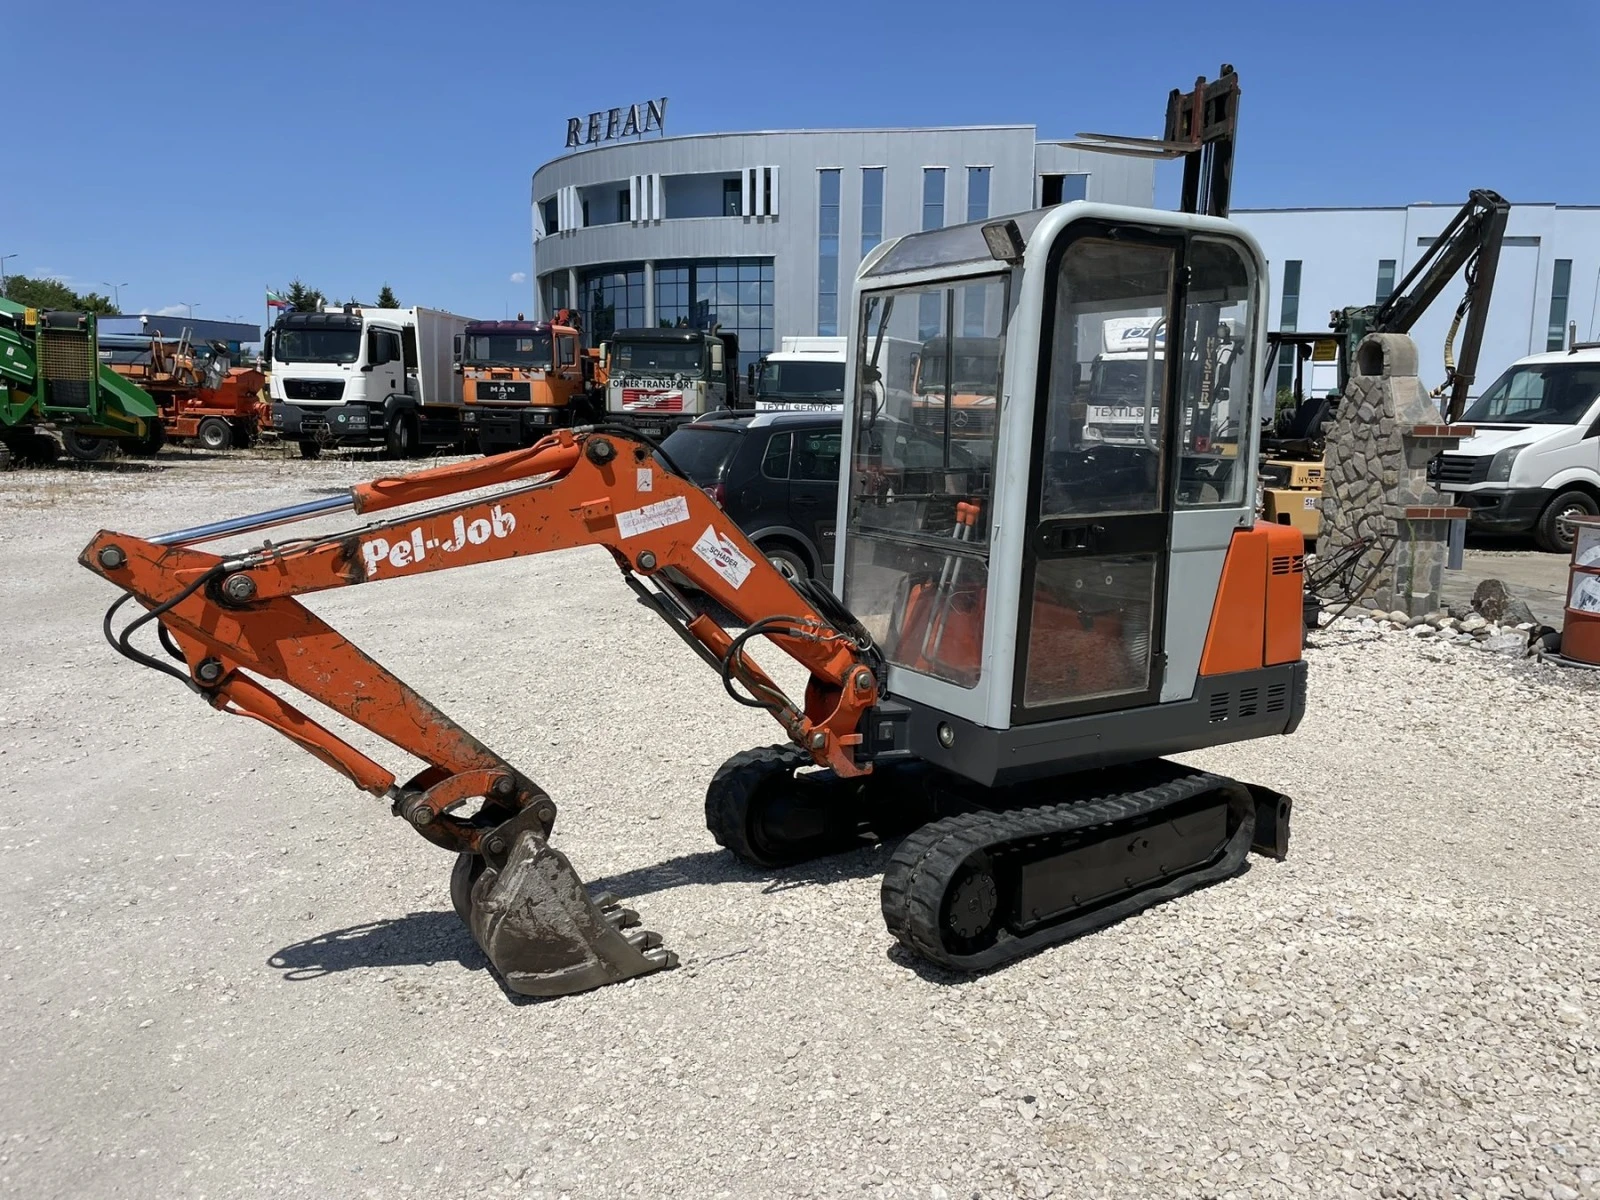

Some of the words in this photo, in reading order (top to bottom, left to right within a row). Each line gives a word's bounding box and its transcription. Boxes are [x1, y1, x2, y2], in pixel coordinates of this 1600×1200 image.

[565, 97, 668, 148] REFAN
[1200, 336, 1215, 405] HYSTER
[362, 504, 516, 577] Pel-Job
[709, 546, 738, 568] SCHADER
